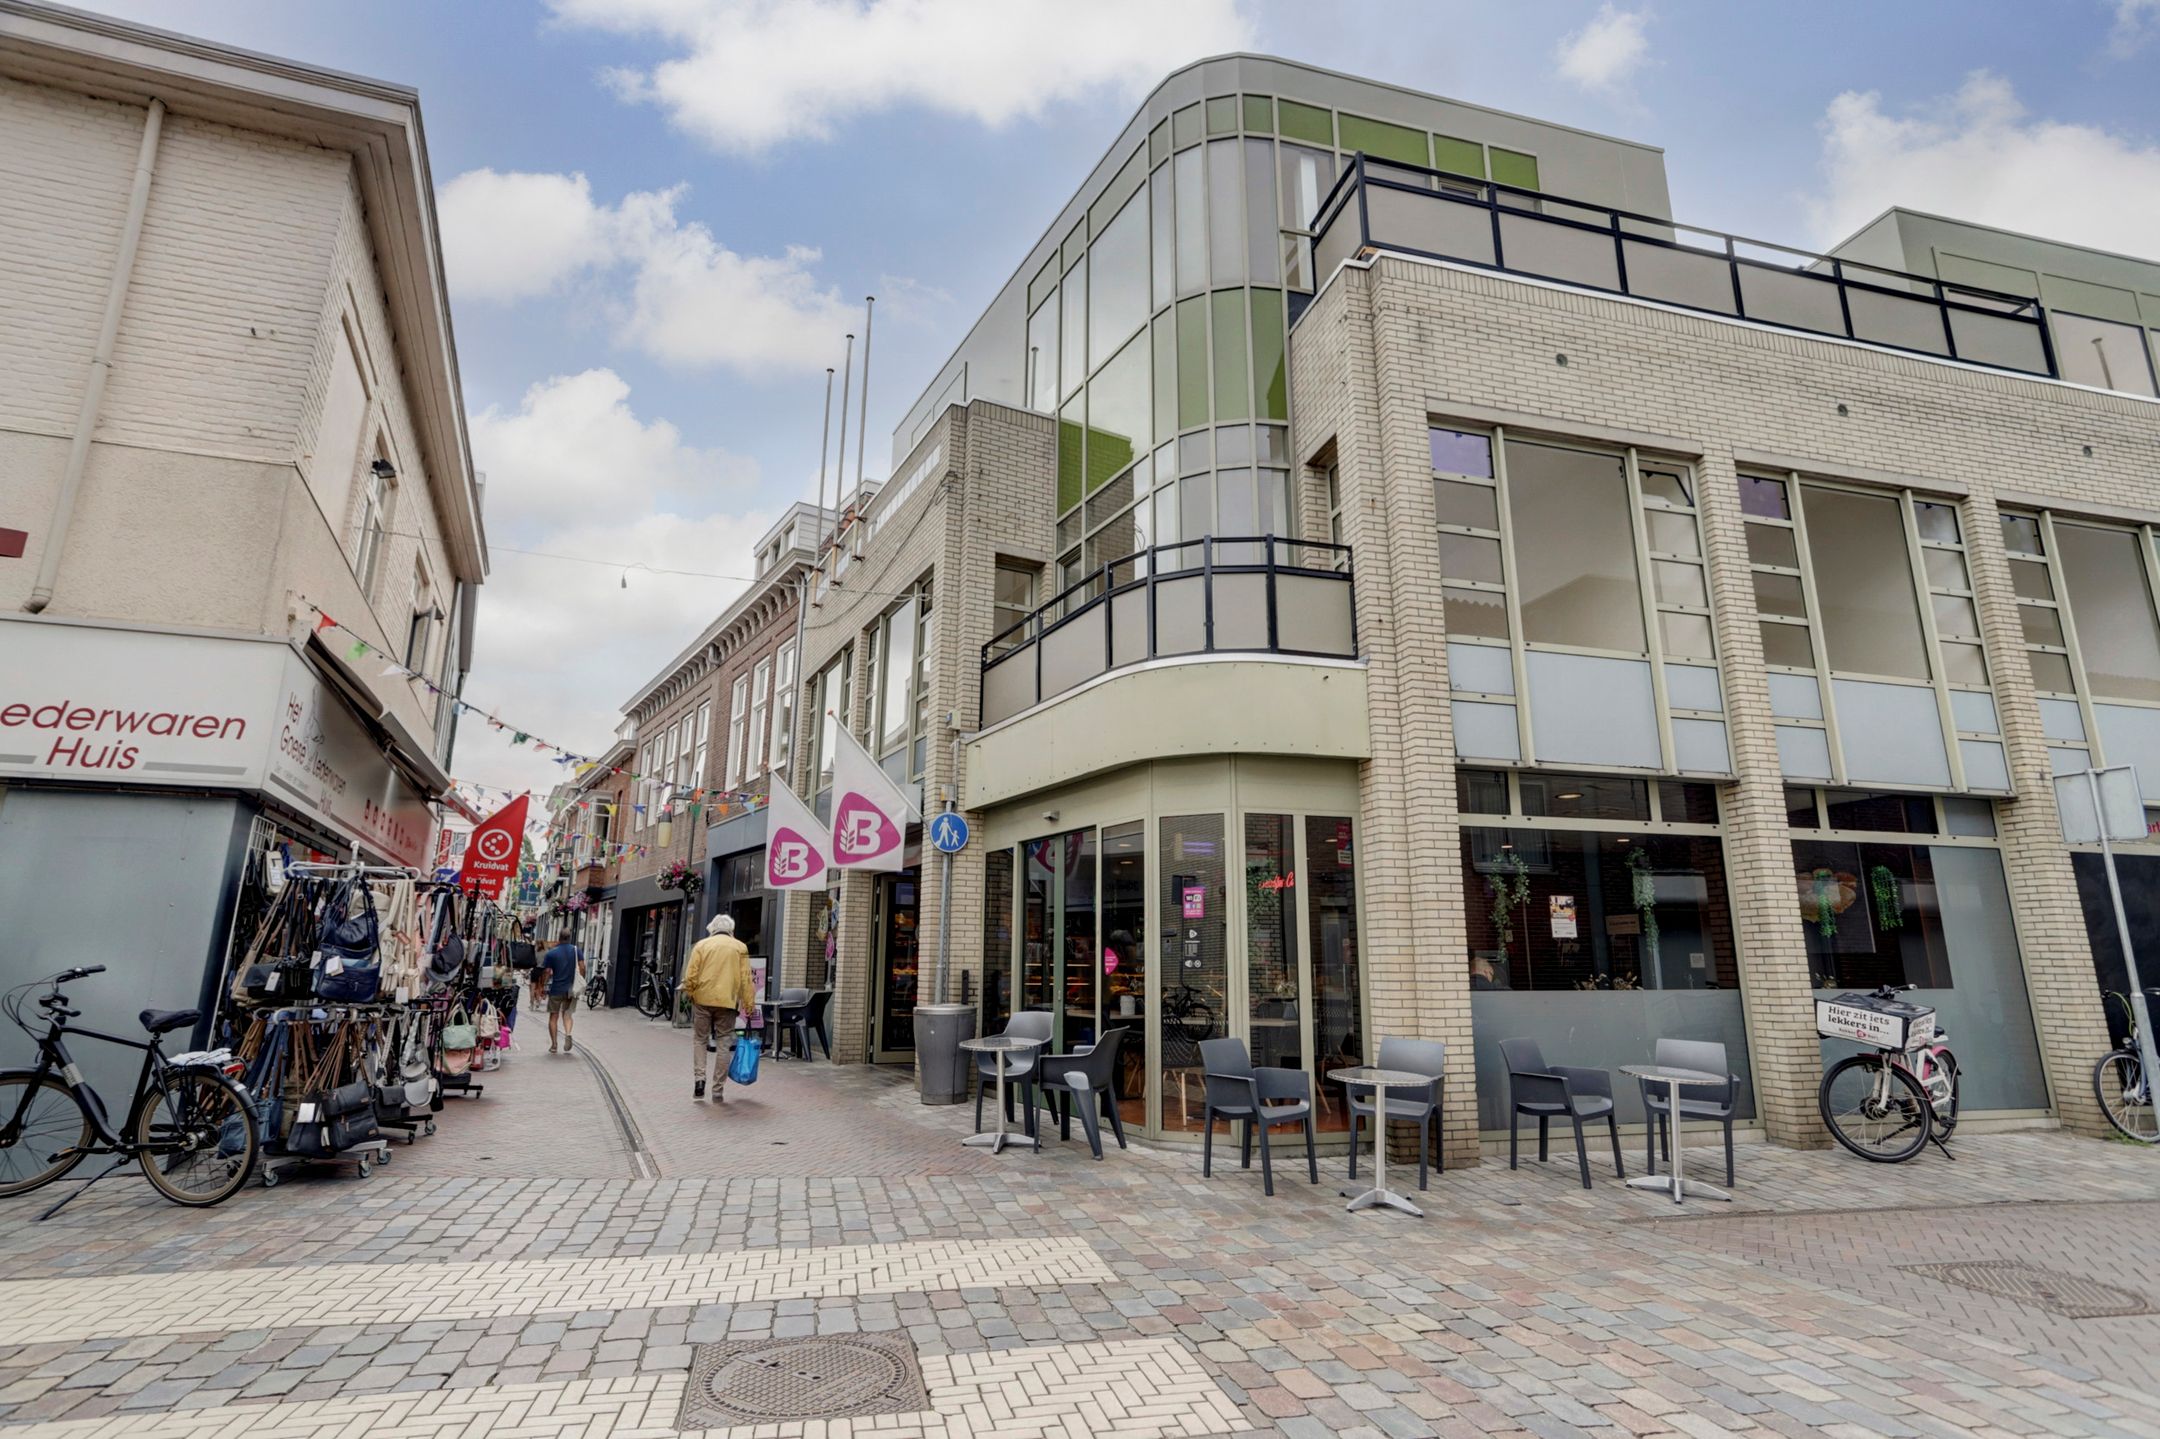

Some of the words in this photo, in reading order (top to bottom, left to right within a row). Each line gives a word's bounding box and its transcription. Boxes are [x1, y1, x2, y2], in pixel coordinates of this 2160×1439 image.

[287, 692, 303, 726] Het
[46, 736, 140, 770] Huis
[280, 725, 307, 766] Goese
[320, 789, 333, 818] Huis
[847, 810, 883, 855] B
[473, 860, 510, 872] Kruidvat
[779, 842, 810, 878] B
[1828, 1006, 1852, 1017] Hier
[1853, 1011, 1867, 1021] zit
[1870, 1014, 1890, 1026] iets
[1828, 1014, 1867, 1030] lekkers
